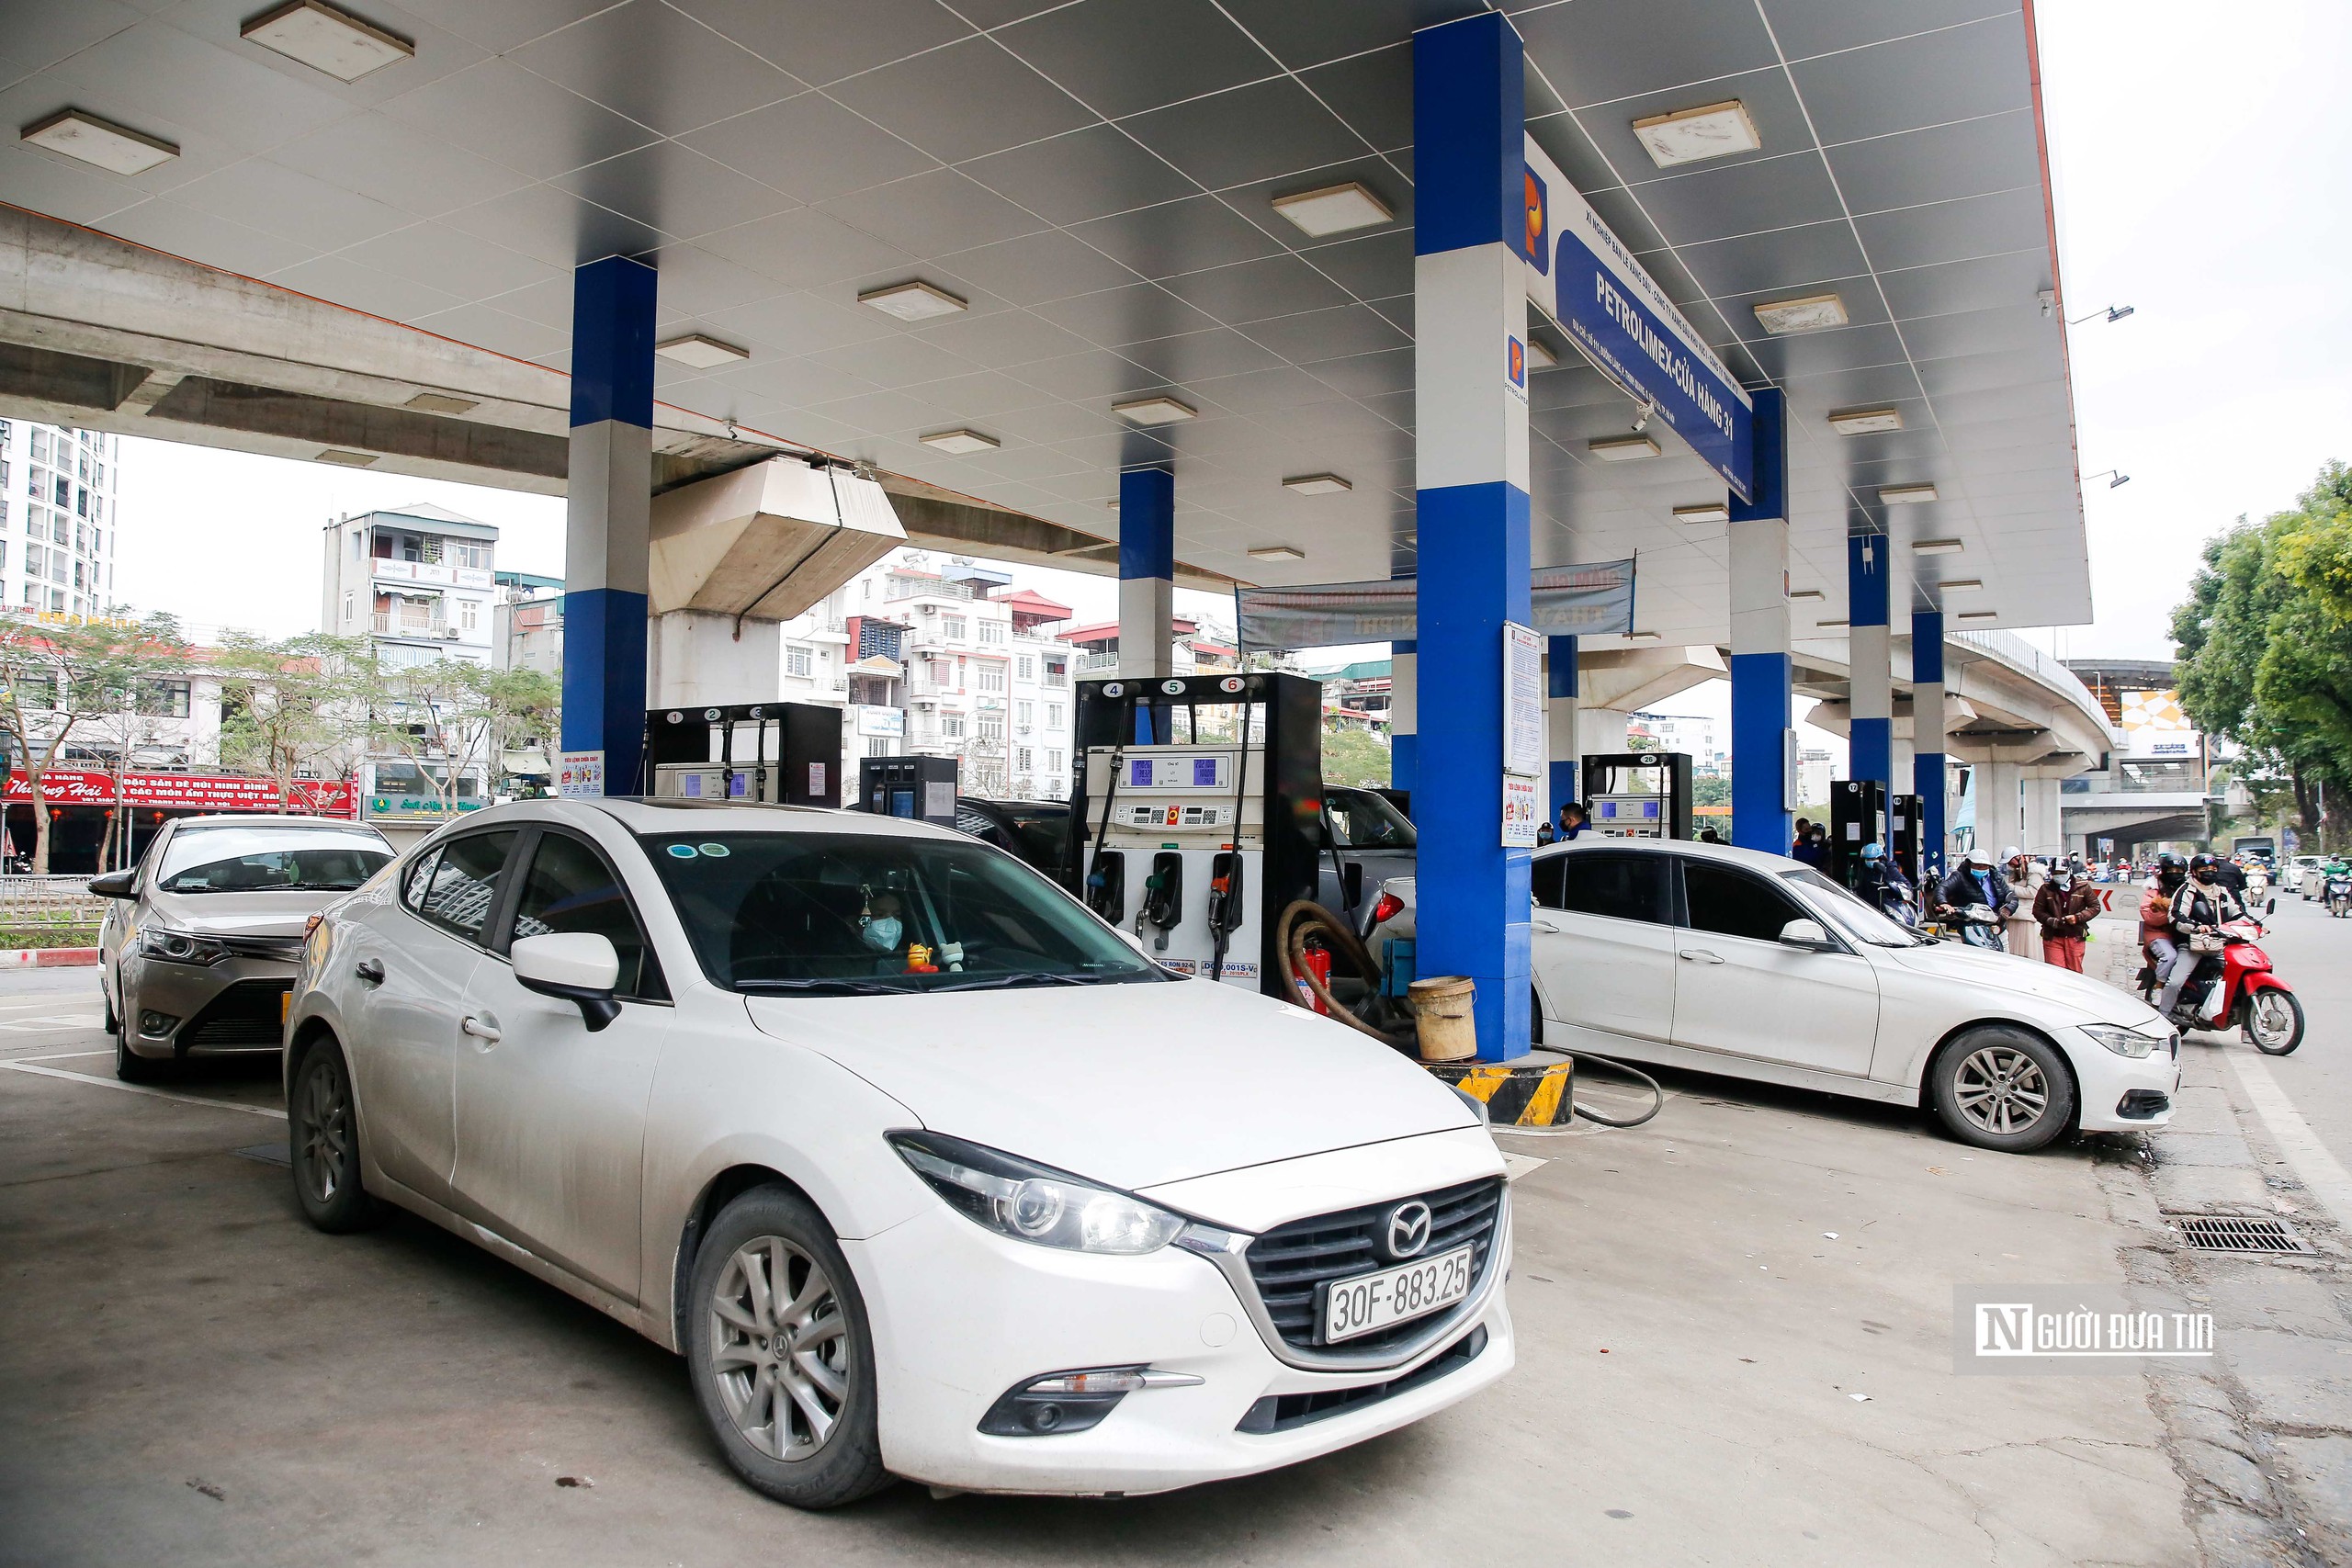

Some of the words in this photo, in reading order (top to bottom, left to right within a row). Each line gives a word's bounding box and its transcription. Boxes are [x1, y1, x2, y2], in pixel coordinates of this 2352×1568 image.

[1596, 271, 1695, 403] PETROLIMEX-CỬA
[1697, 381, 1723, 430] HÀNG
[1724, 412, 1734, 442] 31
[1169, 682, 1178, 693] 5
[1227, 679, 1238, 690] 6
[1110, 685, 1118, 695] 4
[673, 713, 677, 722] 1
[709, 711, 716, 719] 2
[130, 787, 153, 795] CÁC
[214, 782, 241, 790] NINH
[243, 782, 269, 791] BÌNH
[1333, 1253, 1468, 1332] 30F-883.25
